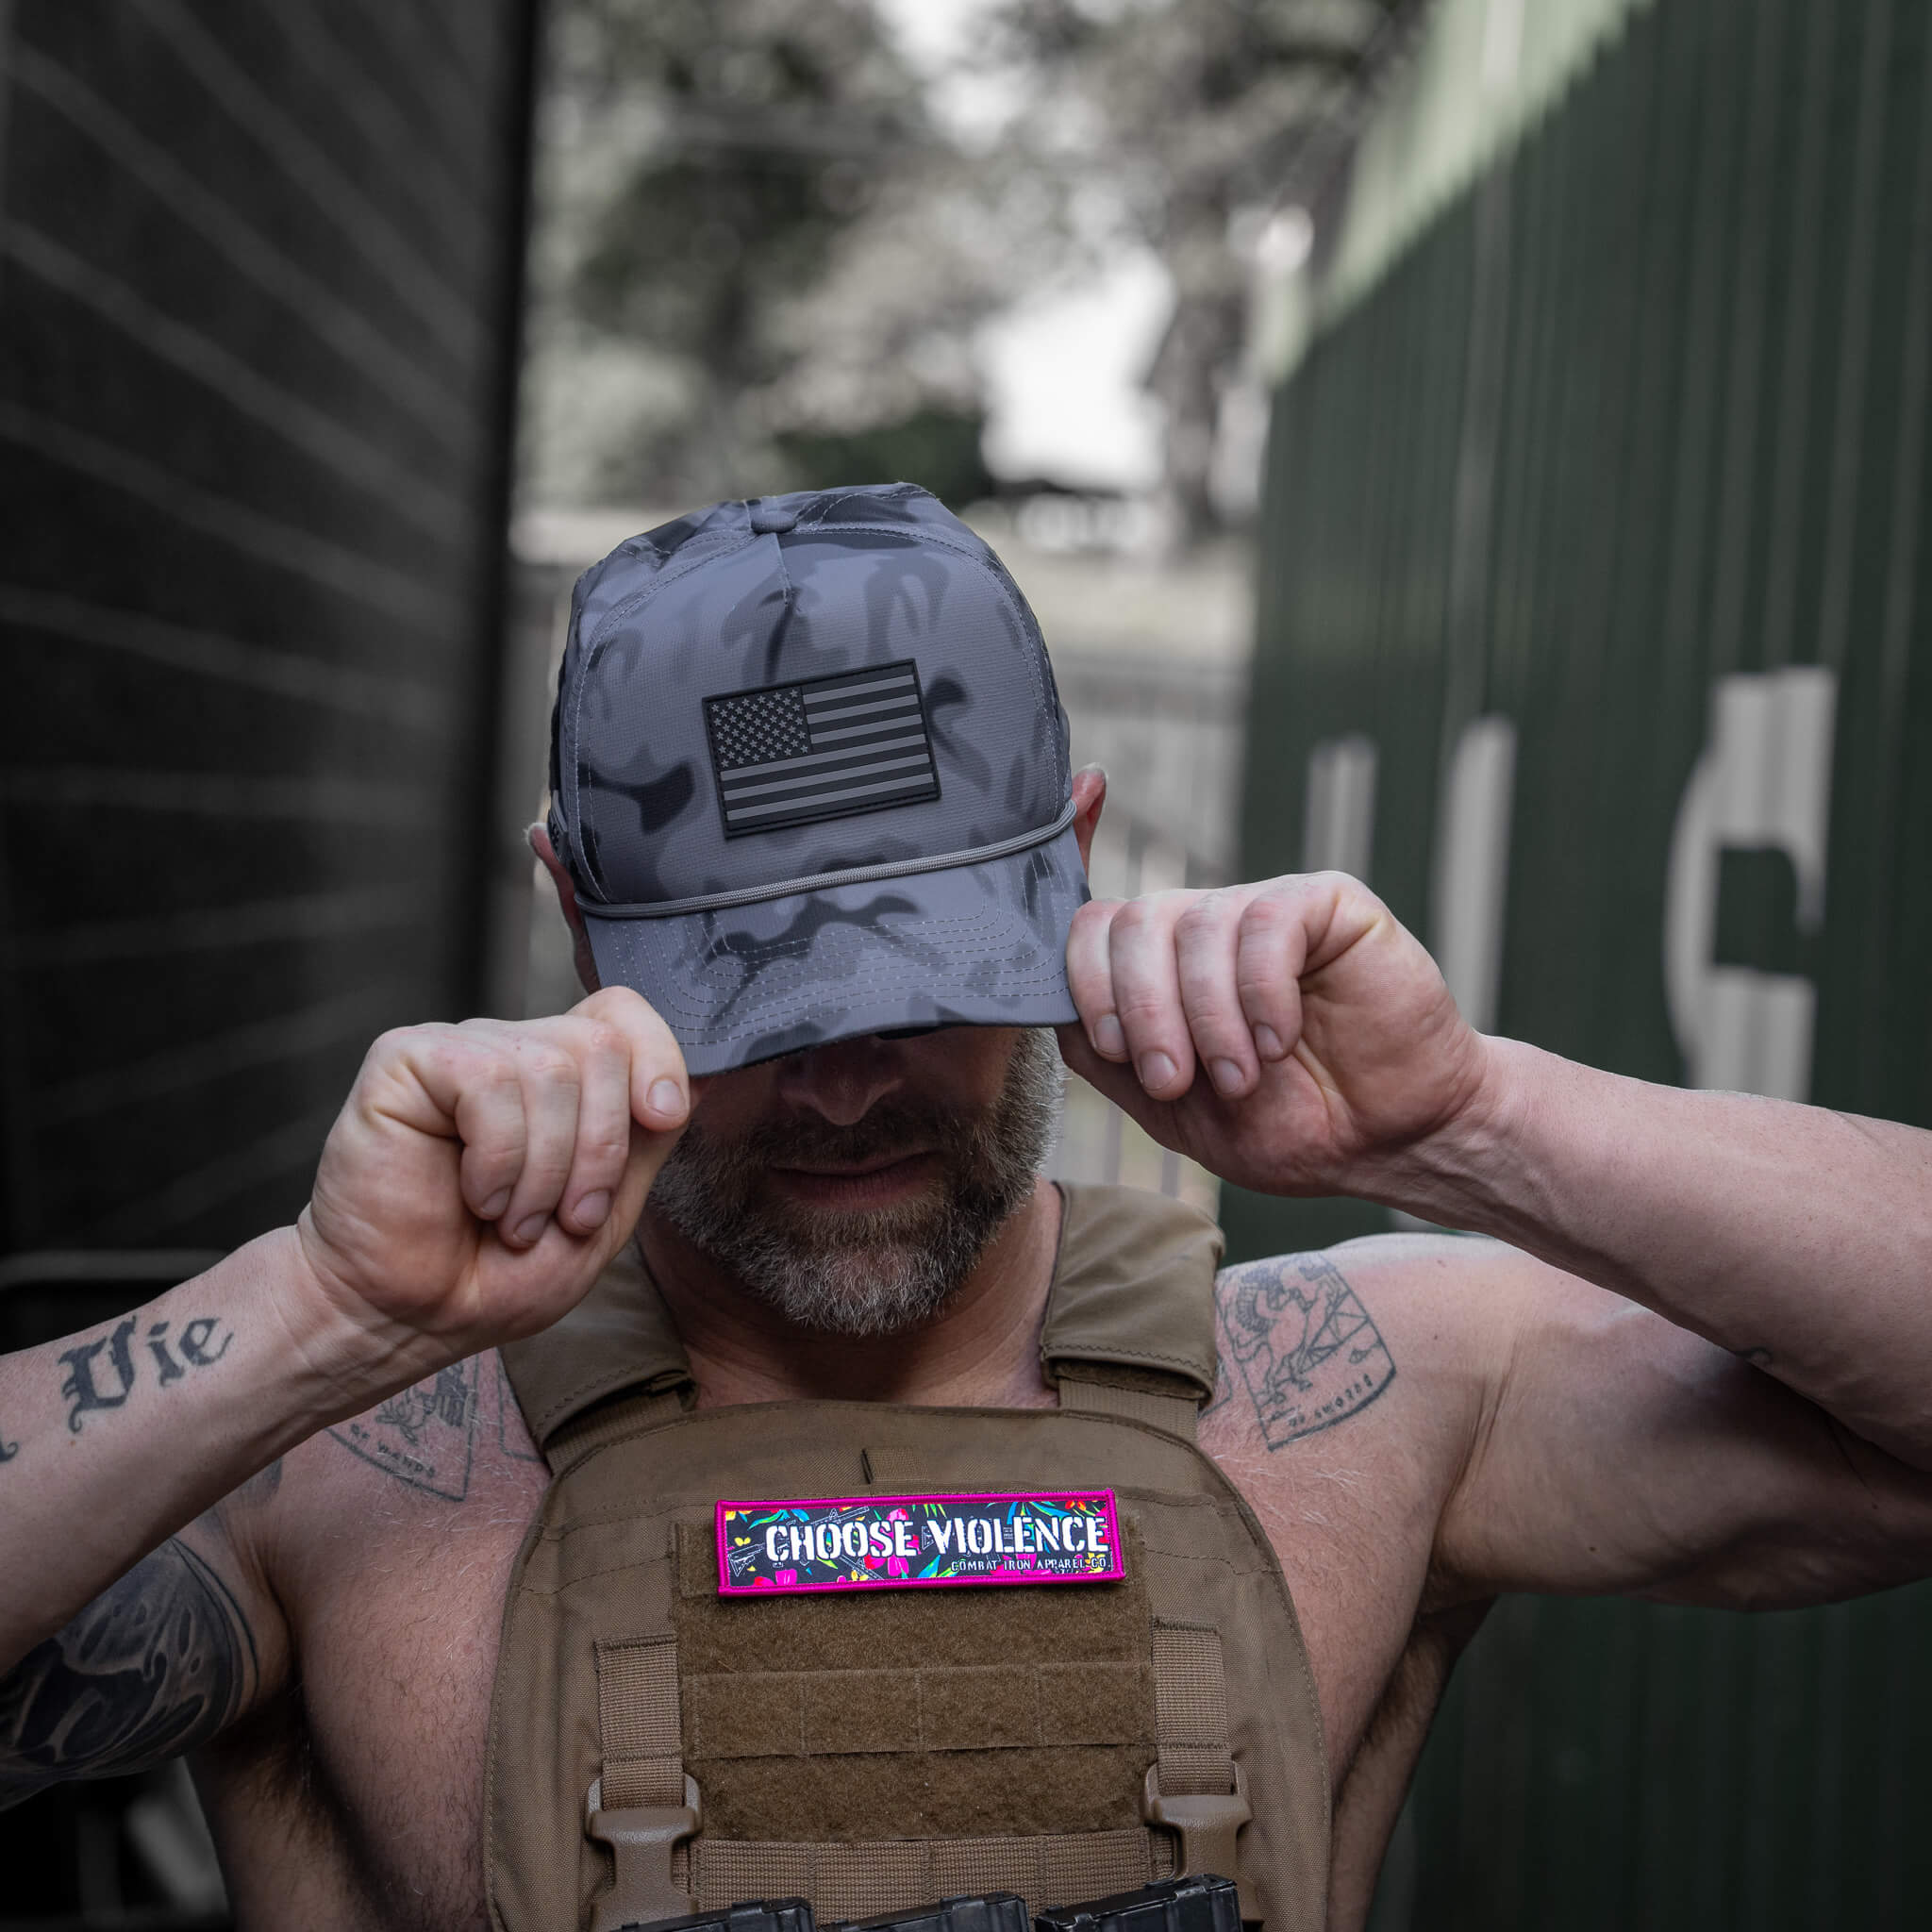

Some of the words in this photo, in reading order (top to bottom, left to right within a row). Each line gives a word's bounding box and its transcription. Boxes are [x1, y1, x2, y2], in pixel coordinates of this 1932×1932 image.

[765, 1521, 917, 1561] CHOOSE
[928, 1517, 1109, 1555] VIOLENCE
[951, 1559, 998, 1572] COMBAT
[1003, 1558, 1032, 1571] IRON
[1037, 1557, 1085, 1570] APPAREL
[1091, 1557, 1111, 1569] CO.
